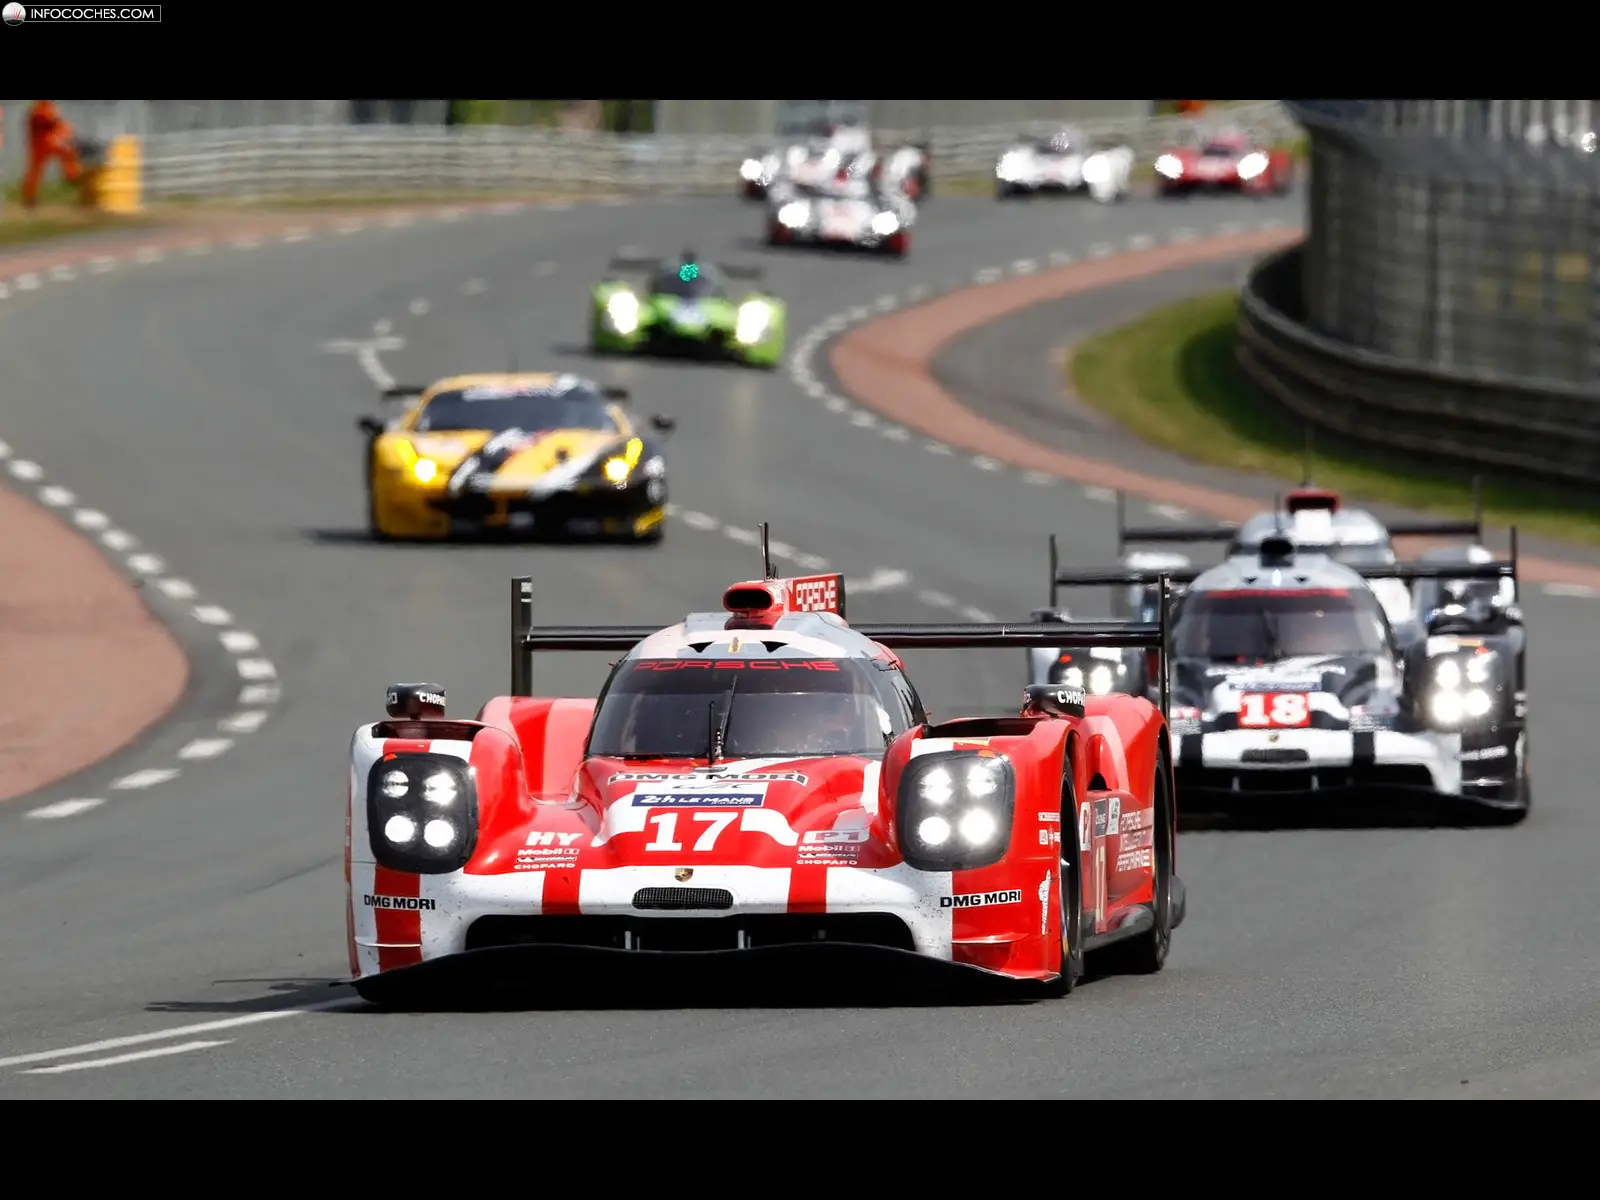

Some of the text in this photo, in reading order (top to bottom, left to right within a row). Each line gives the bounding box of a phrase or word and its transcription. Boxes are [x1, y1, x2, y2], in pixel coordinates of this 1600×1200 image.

[633, 660, 841, 672] PORSCHE
[1239, 694, 1308, 726] 18
[525, 831, 584, 846] HY
[644, 811, 739, 852] 17
[814, 831, 860, 841] P1
[517, 848, 563, 856] Mobil
[363, 894, 437, 911] DMG MORI
[939, 890, 1022, 908] DMG MORI
